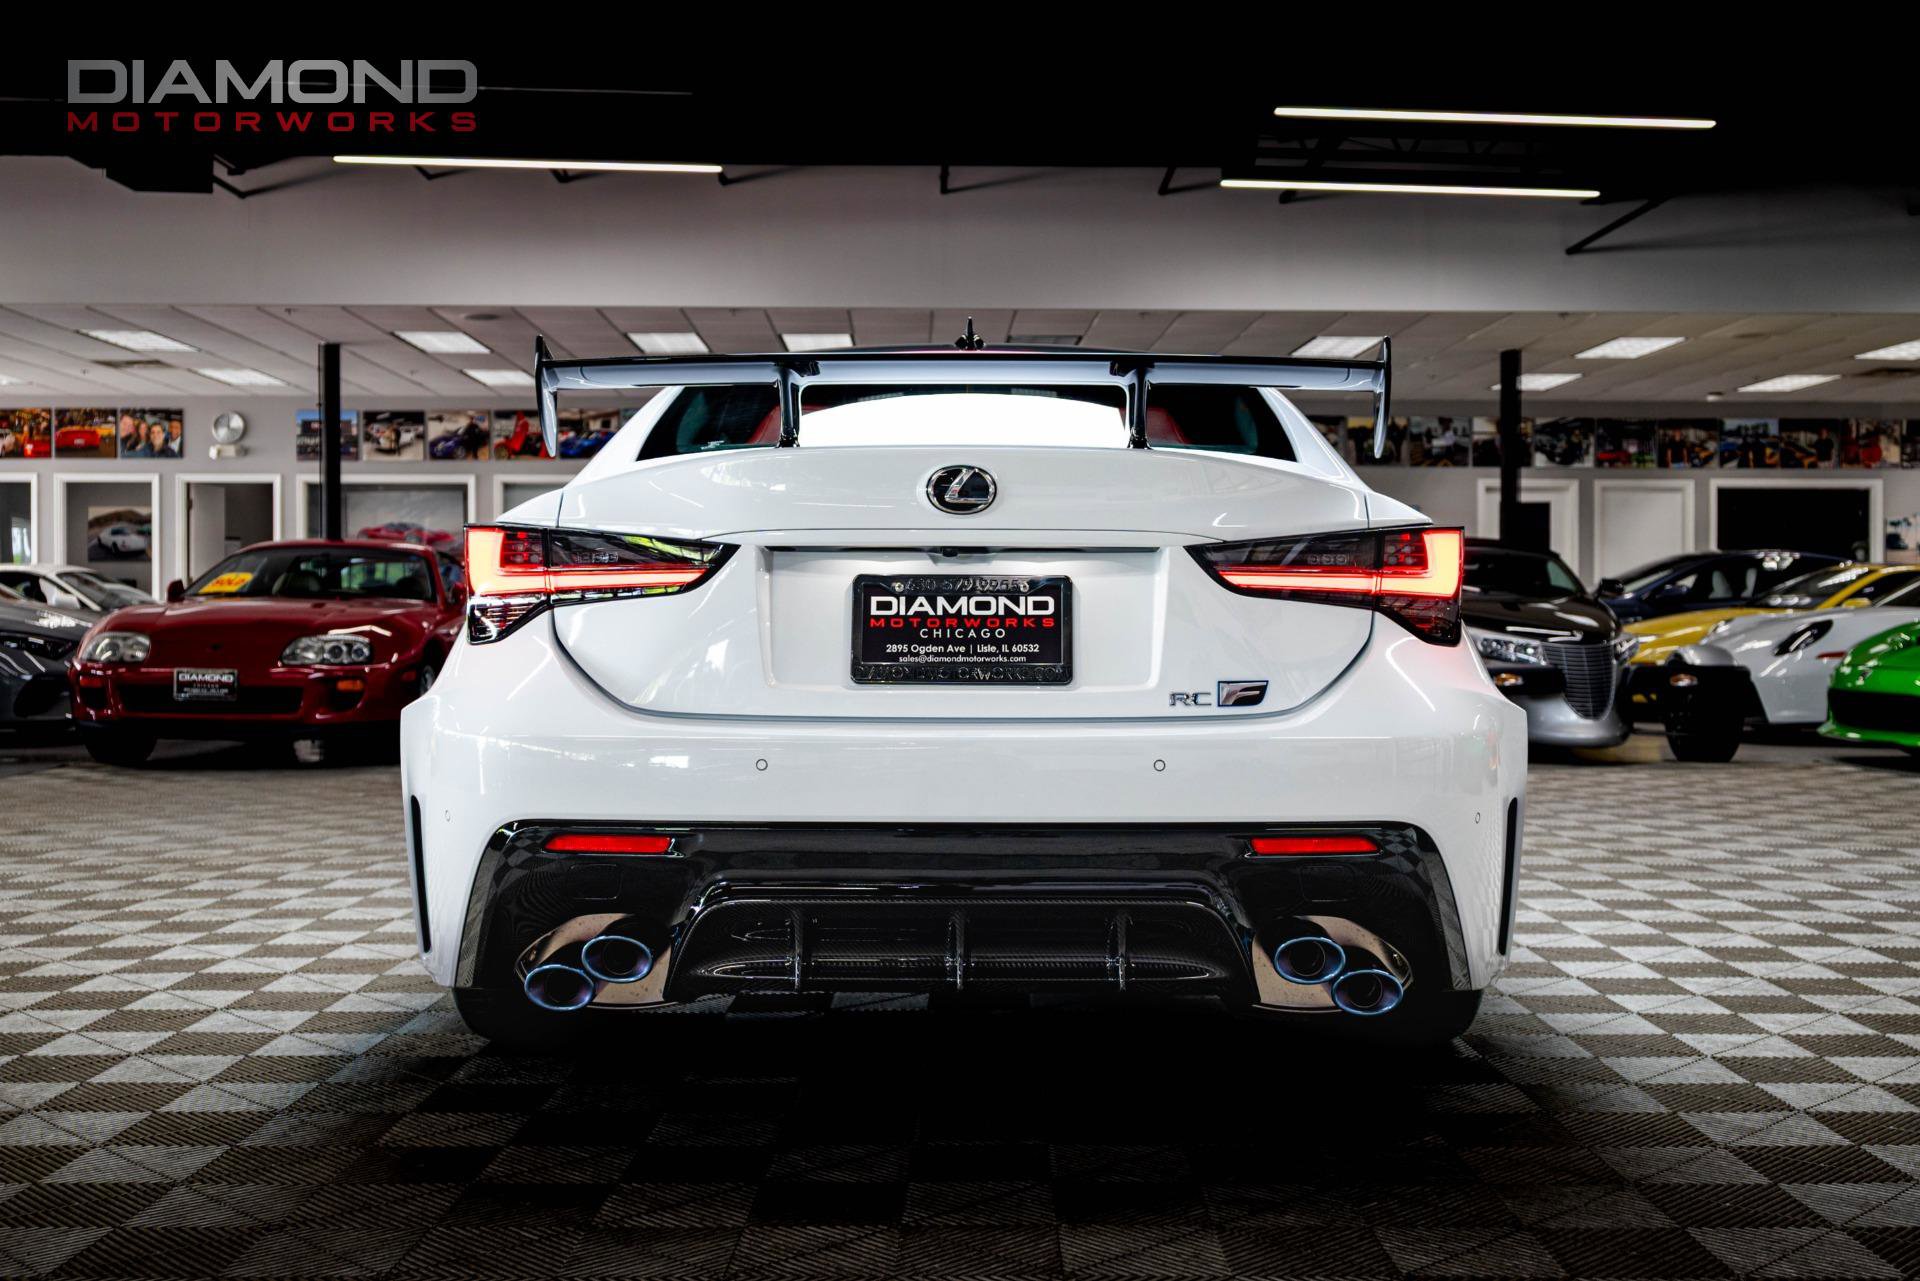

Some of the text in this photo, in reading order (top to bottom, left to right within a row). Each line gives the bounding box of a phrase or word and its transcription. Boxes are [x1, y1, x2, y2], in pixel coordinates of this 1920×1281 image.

[870, 596, 1055, 616] DIAMOND
[869, 617, 1055, 628] MOTORWORKS
[920, 628, 1006, 638] CHICAGO
[886, 644, 909, 653] 2895
[910, 644, 944, 654] Ogden
[946, 644, 966, 653] Ave
[977, 644, 999, 654] Lisle,
[1001, 644, 1010, 653] IL
[1011, 644, 1040, 653] 60532
[898, 654, 1027, 663] sales@diamondmotorworks.com
[178, 673, 234, 681] DIAMOND
[1169, 691, 1212, 706] RC
